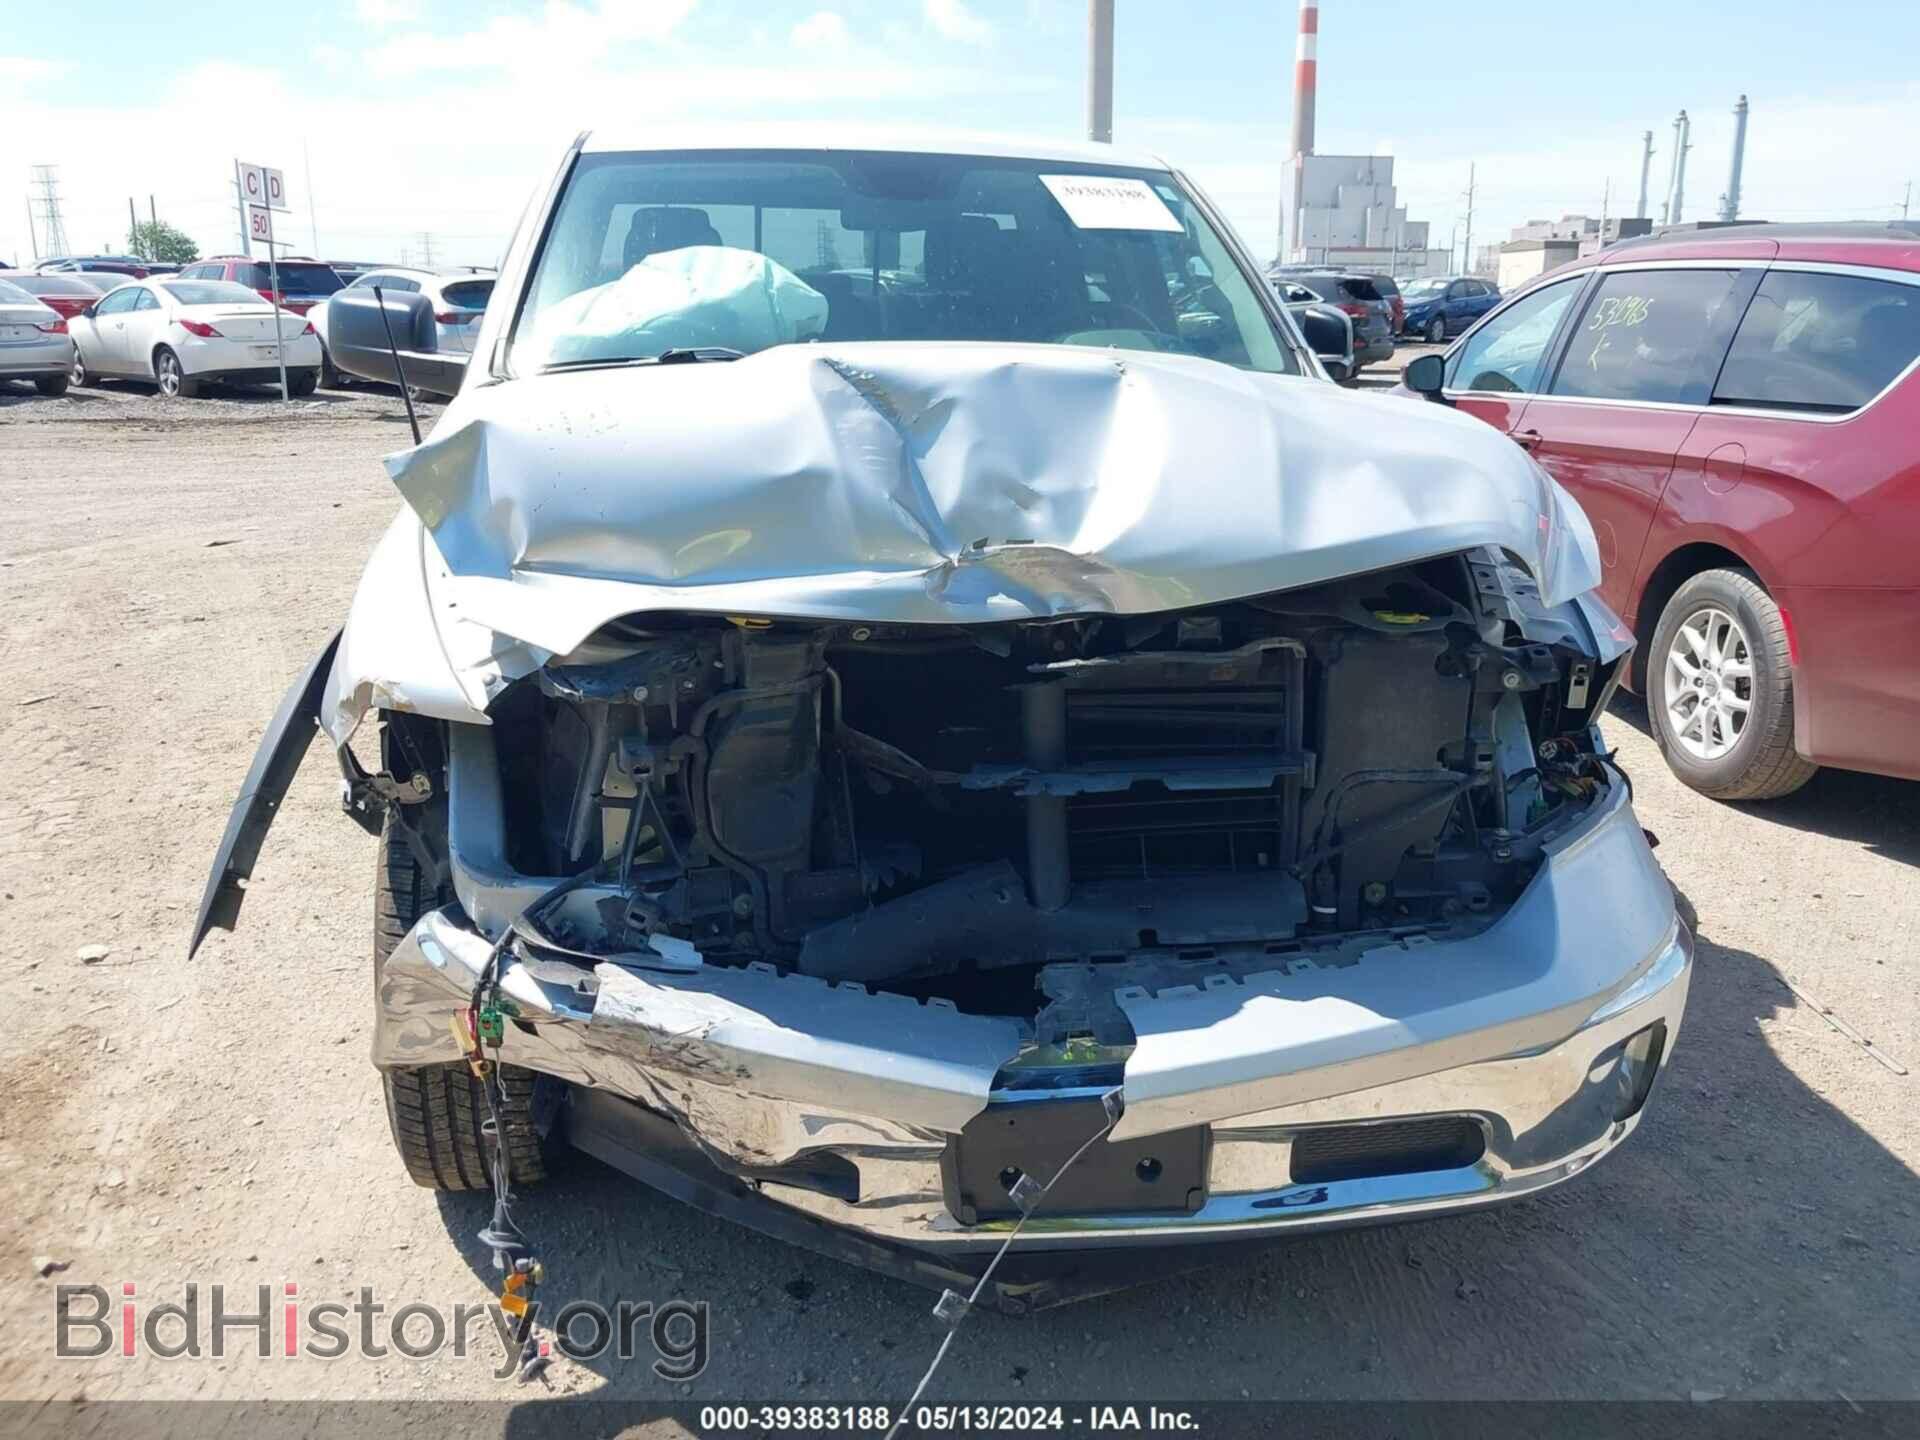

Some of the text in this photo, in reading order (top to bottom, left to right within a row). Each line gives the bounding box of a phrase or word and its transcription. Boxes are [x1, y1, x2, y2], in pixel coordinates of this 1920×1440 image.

[247, 172, 258, 195] C
[270, 176, 280, 198] D
[253, 214, 267, 234] 50
